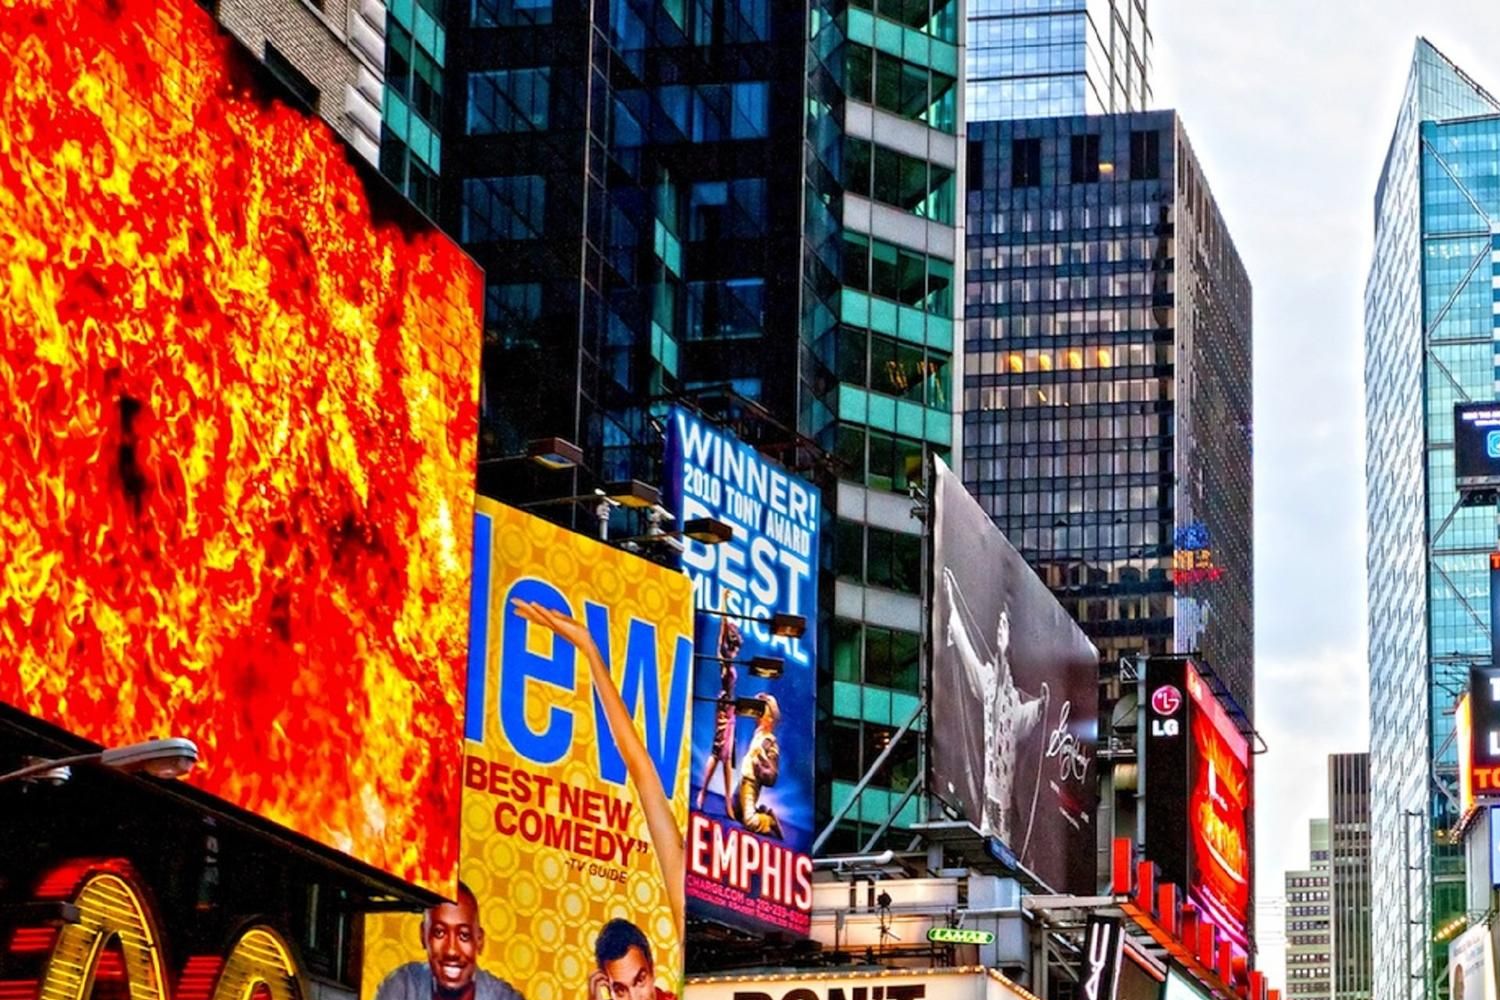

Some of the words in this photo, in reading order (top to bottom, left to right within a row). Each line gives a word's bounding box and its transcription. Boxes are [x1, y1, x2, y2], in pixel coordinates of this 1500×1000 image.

[677, 413, 816, 531] WINNER!
[683, 463, 721, 507] 2010
[725, 487, 763, 531] TONY
[766, 510, 810, 557] AWARD
[681, 496, 810, 615] BEST
[1152, 720, 1179, 736] LG
[465, 755, 553, 808] BEST
[559, 783, 633, 832] NEW
[588, 863, 628, 883] GUIDE
[936, 929, 989, 943] LAMAR
